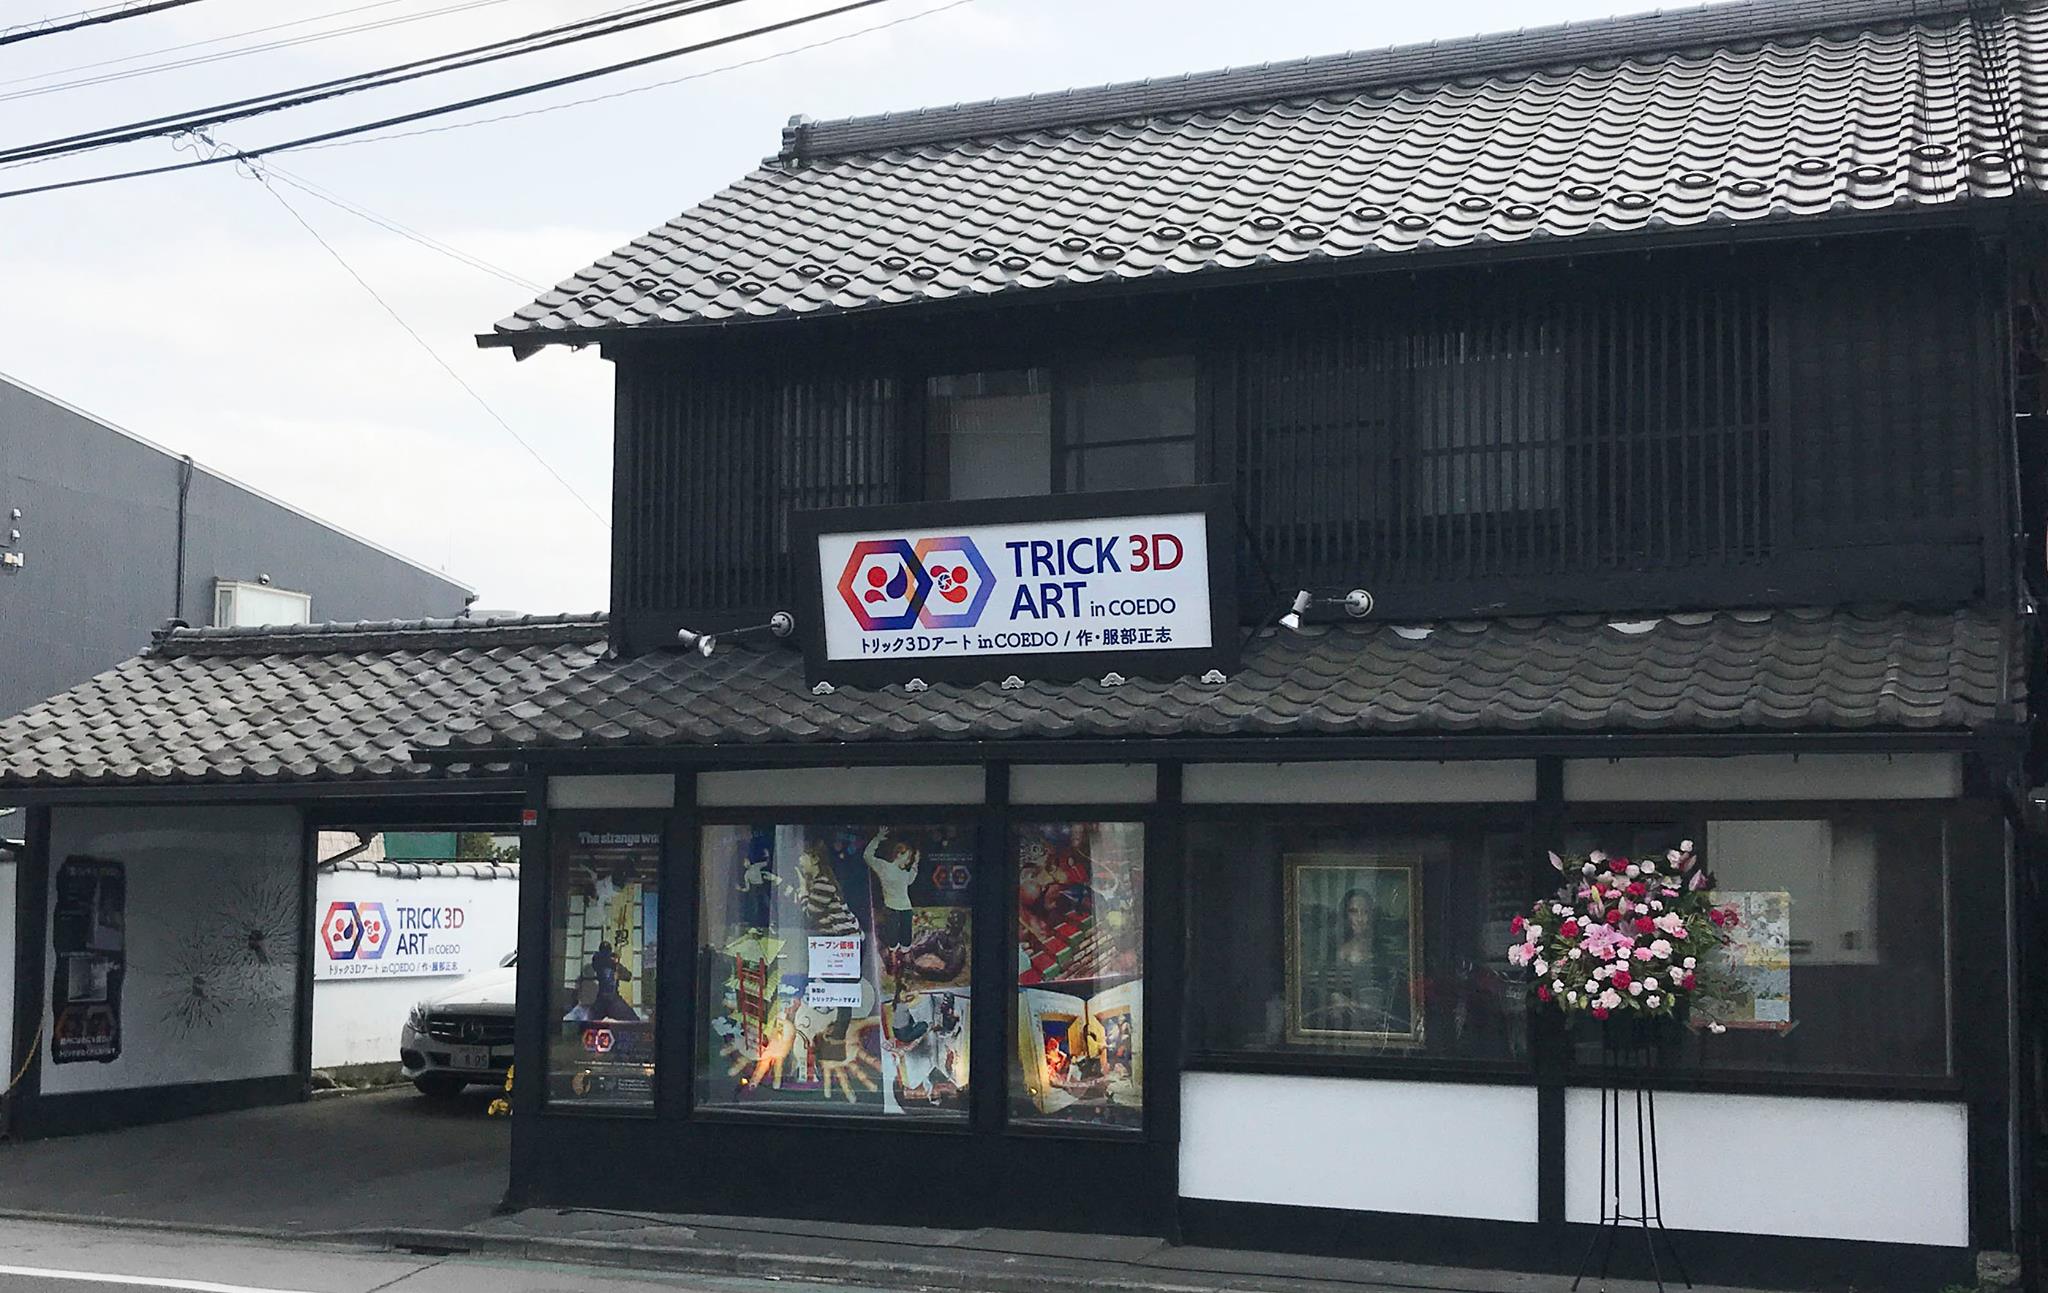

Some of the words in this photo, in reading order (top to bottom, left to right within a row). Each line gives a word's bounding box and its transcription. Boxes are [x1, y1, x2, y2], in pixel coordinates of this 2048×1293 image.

[1005, 536, 1121, 577] TRICK
[1129, 533, 1184, 572] 3D
[1009, 581, 1087, 620] ART
[1090, 601, 1106, 617] in
[1109, 598, 1176, 616] COEDO
[861, 634, 971, 653] トリック3Dアート
[397, 907, 441, 930] TRICK
[444, 907, 465, 929] 3D
[396, 933, 428, 955] ART
